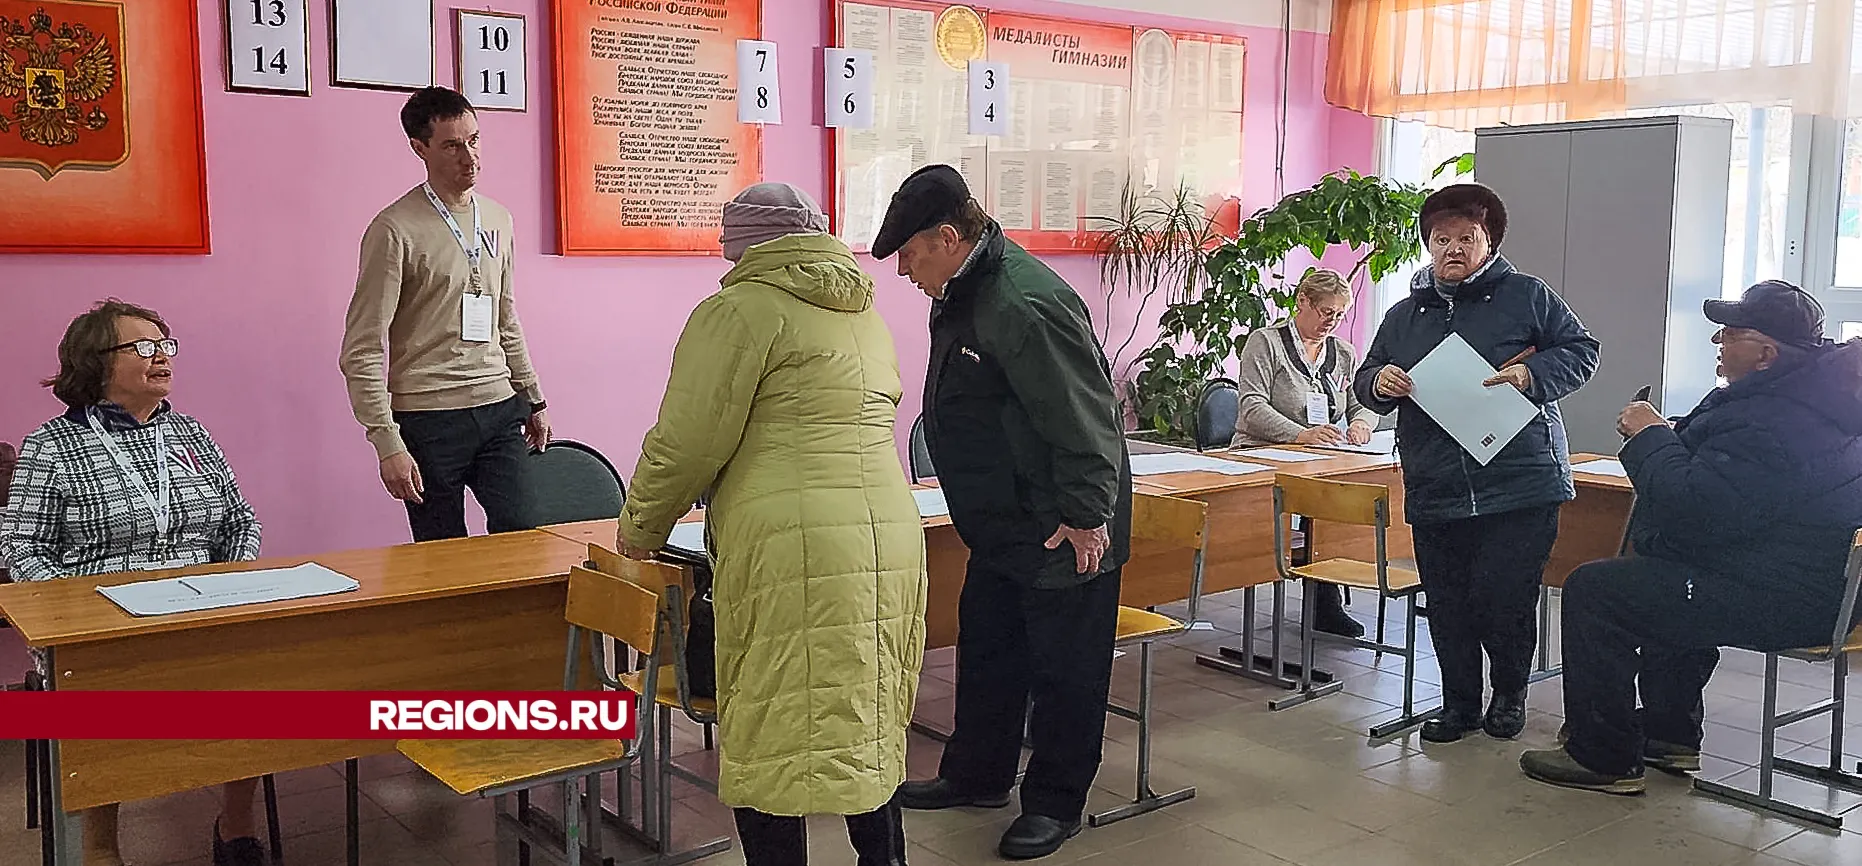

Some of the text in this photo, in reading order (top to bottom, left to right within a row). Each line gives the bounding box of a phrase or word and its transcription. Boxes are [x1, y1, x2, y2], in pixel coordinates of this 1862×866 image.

[250, 0, 287, 27] 13
[479, 25, 509, 52] 10
[993, 26, 1079, 49] МЕДАЛИСТЫ
[252, 46, 288, 75] 14
[755, 49, 767, 72] 7
[843, 57, 855, 79] 5
[1052, 49, 1127, 69] ГИМНАЗИИ
[480, 69, 509, 95] 11
[984, 69, 995, 90] 3
[756, 86, 768, 109] 8
[843, 92, 856, 114] 6
[984, 102, 995, 123] 4
